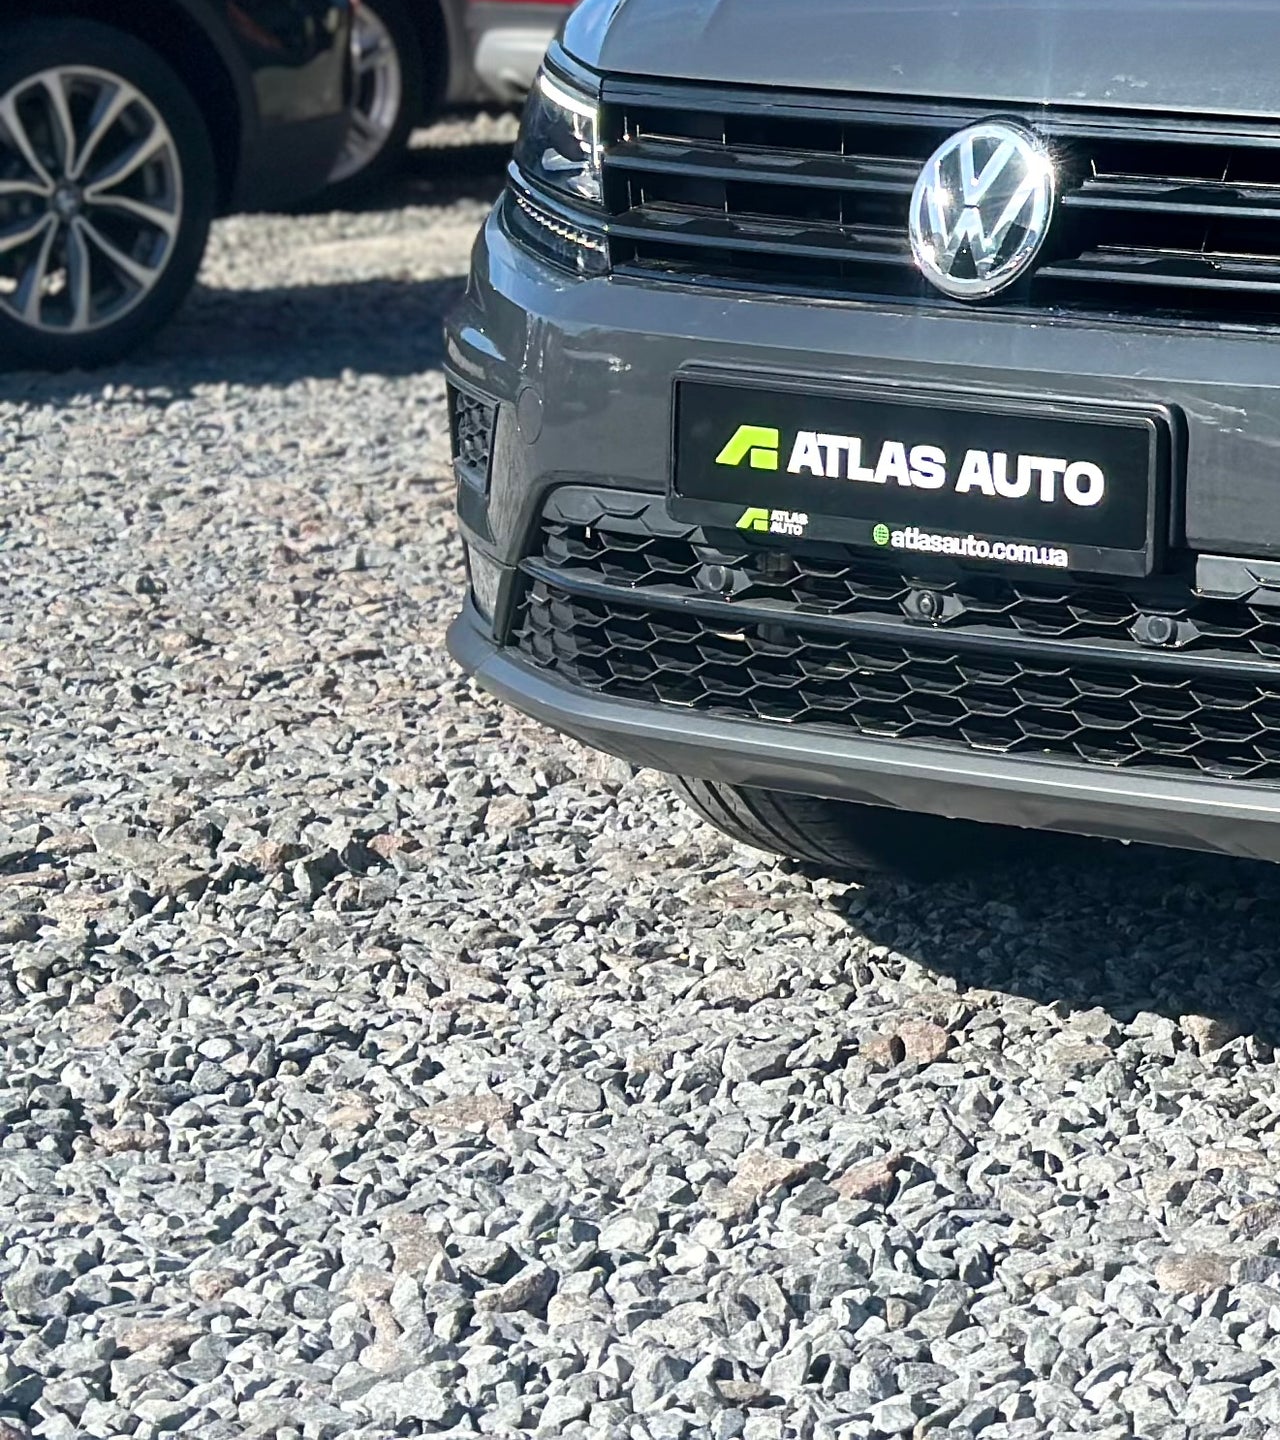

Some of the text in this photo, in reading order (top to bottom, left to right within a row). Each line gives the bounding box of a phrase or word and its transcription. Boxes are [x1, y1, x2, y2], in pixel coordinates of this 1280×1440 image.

[786, 431, 1105, 507] ATLAS AUTO
[769, 521, 803, 536] AUTO
[770, 510, 808, 525] ATLAS
[891, 527, 1069, 568] atlasauto.com.ua
